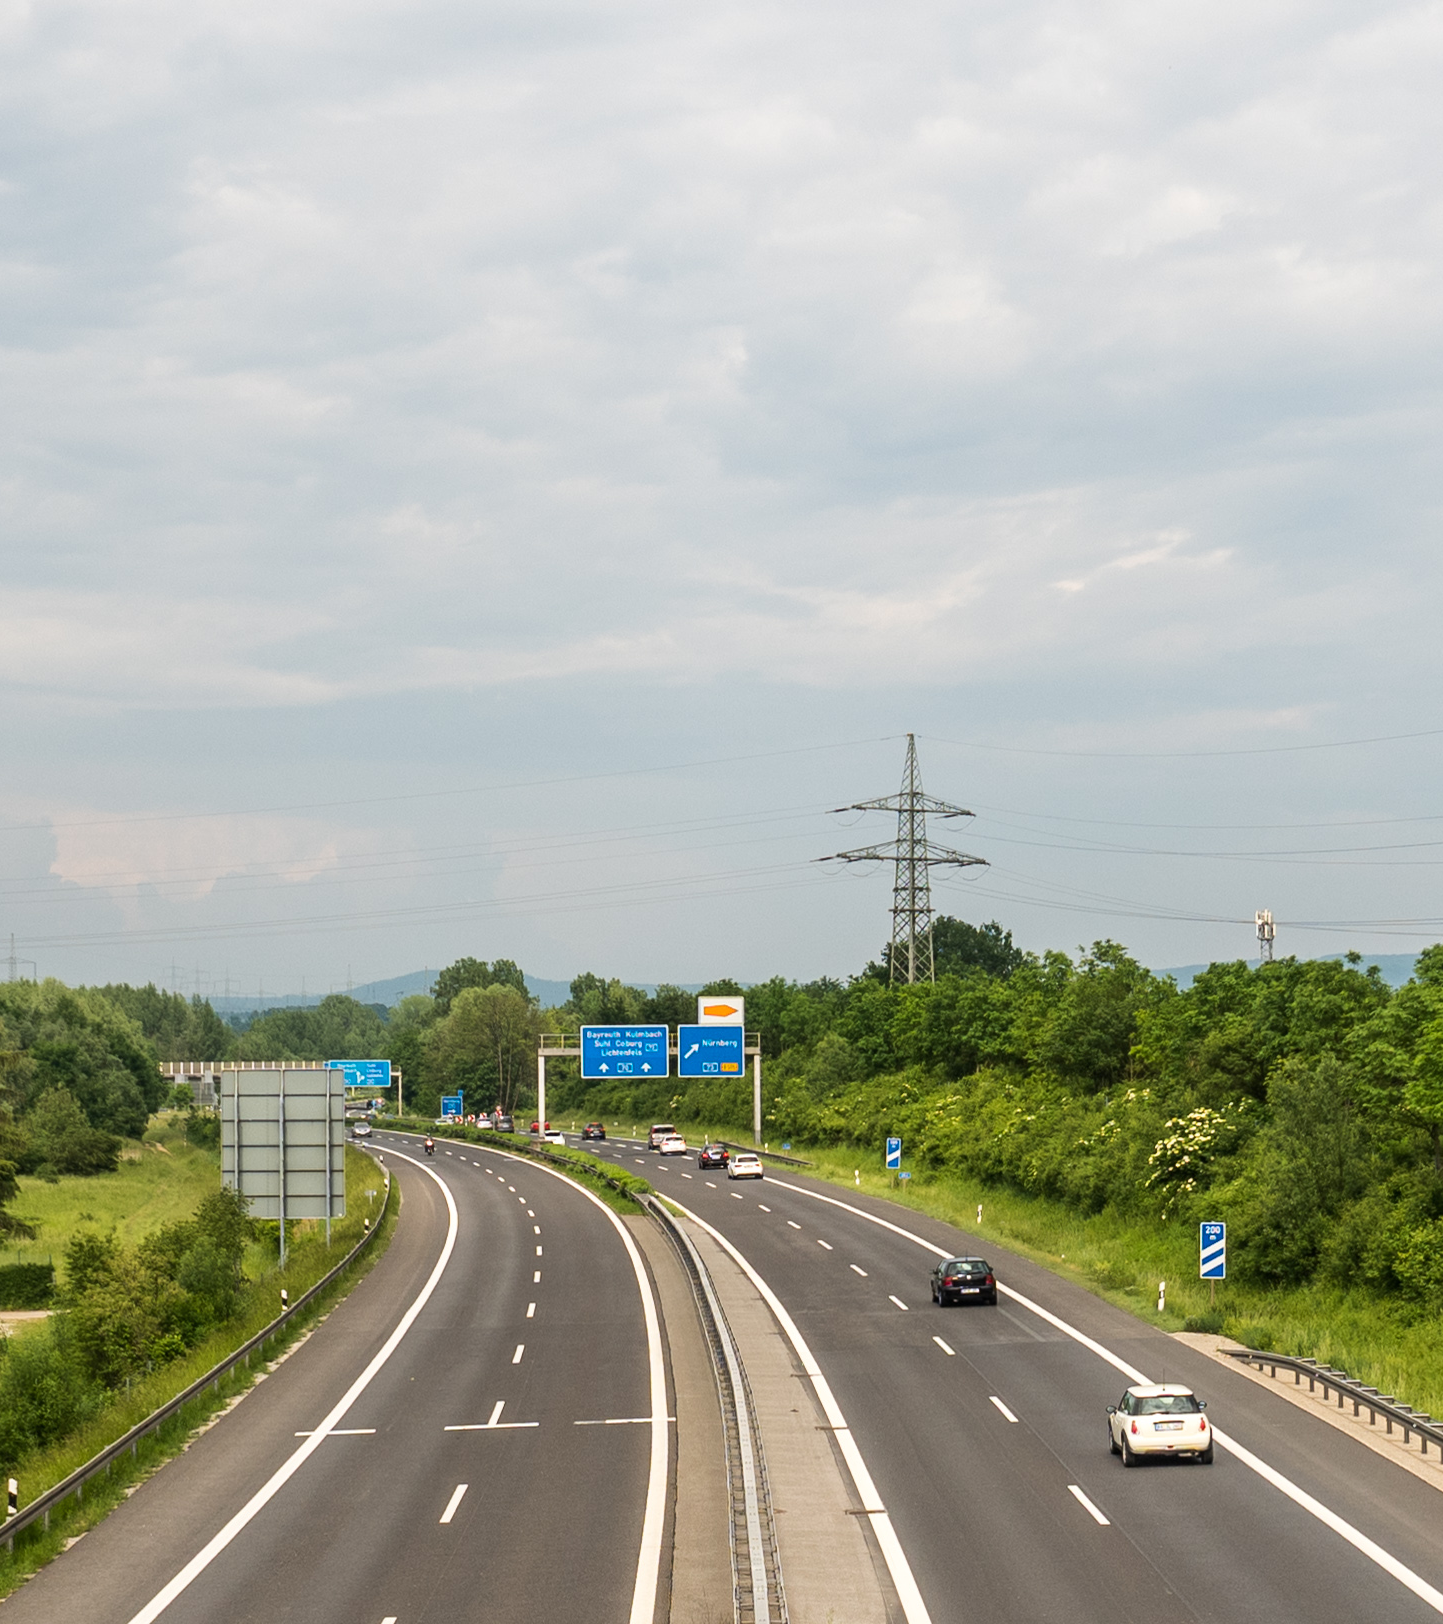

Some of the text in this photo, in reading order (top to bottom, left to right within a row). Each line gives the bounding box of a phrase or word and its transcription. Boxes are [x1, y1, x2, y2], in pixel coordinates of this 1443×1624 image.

[586, 1030, 663, 1040] Bayreuth Kulmbach
[594, 1039, 611, 1047] Suhl
[615, 1039, 643, 1048] Coburg
[702, 1038, 738, 1048] Nürnberg
[601, 1048, 643, 1057] Lichtenfels
[1205, 1225, 1221, 1234] 200
